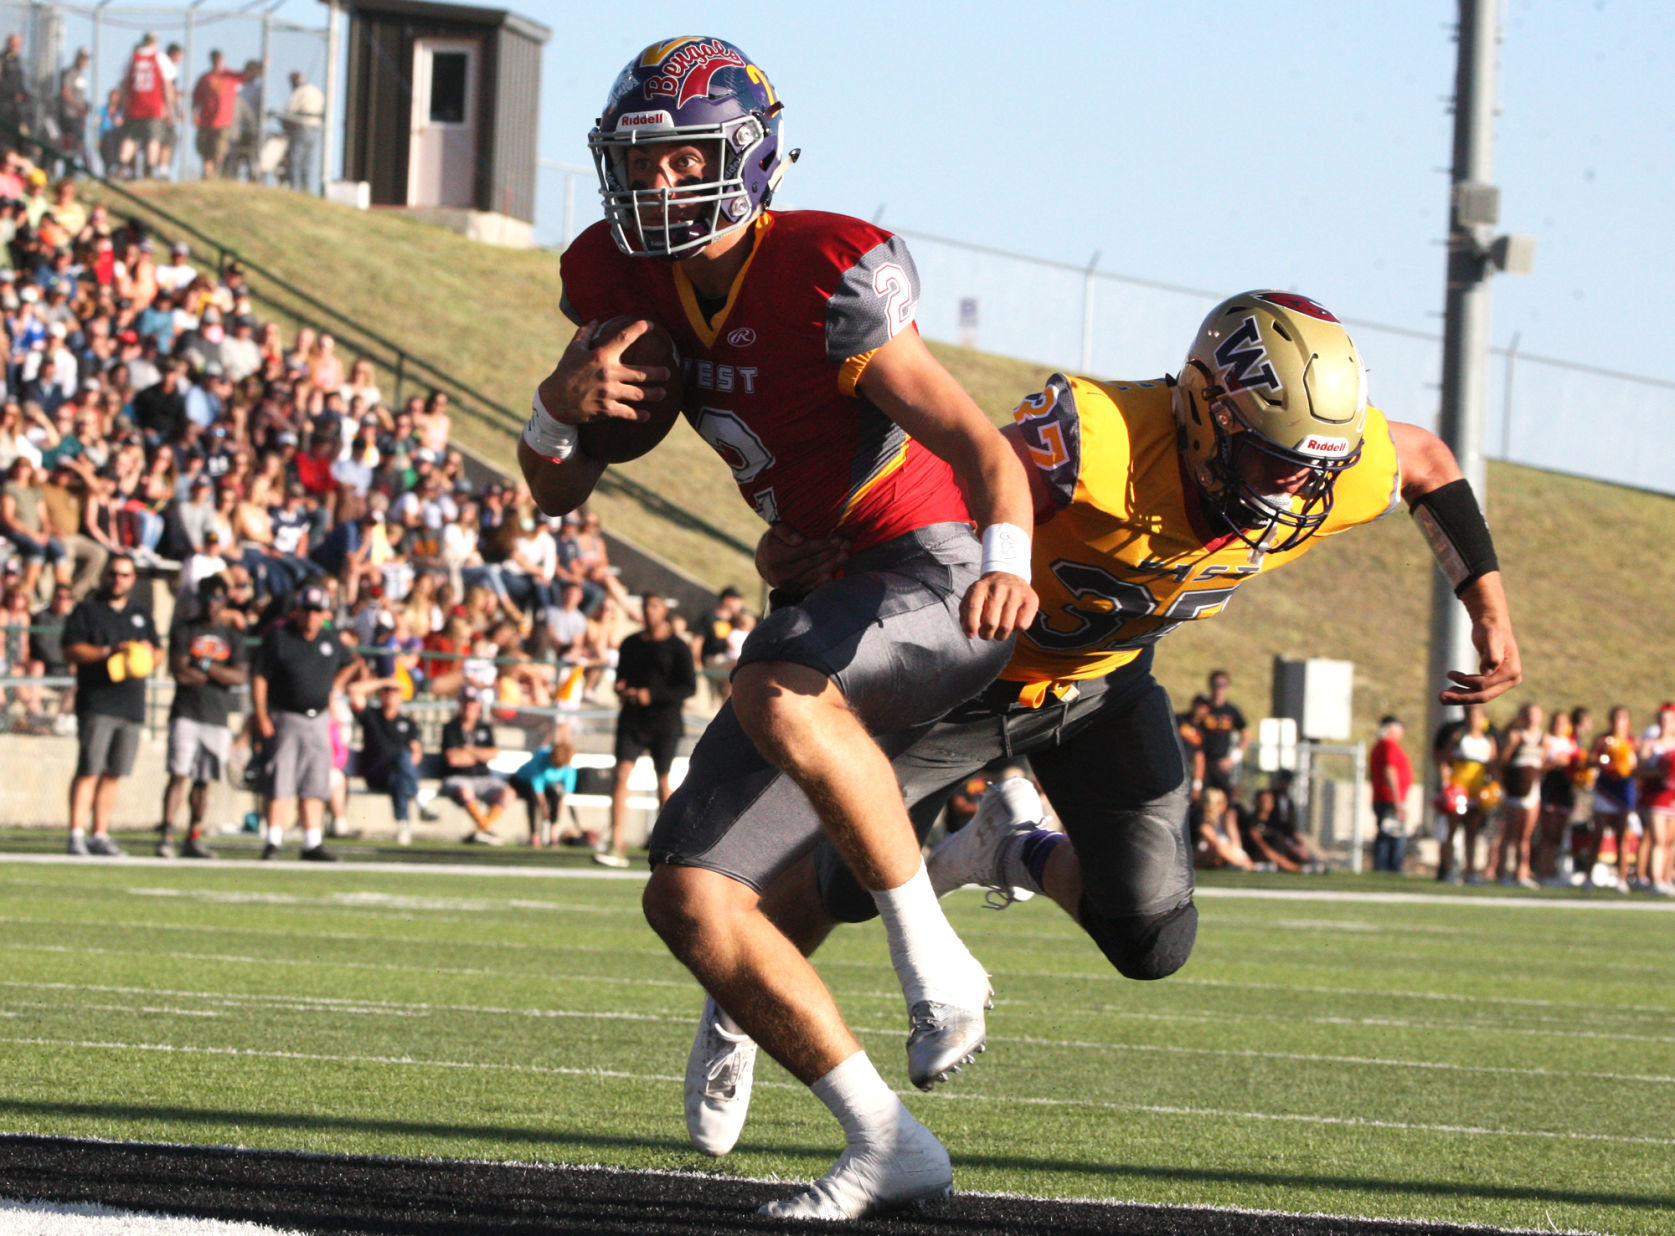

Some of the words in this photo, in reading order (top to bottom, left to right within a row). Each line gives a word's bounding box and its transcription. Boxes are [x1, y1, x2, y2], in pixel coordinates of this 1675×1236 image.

[643, 39, 746, 100] Bengals
[621, 113, 663, 126] Riddell
[872, 262, 917, 340] 2
[1214, 315, 1283, 394] W
[1307, 439, 1346, 453] Riddell
